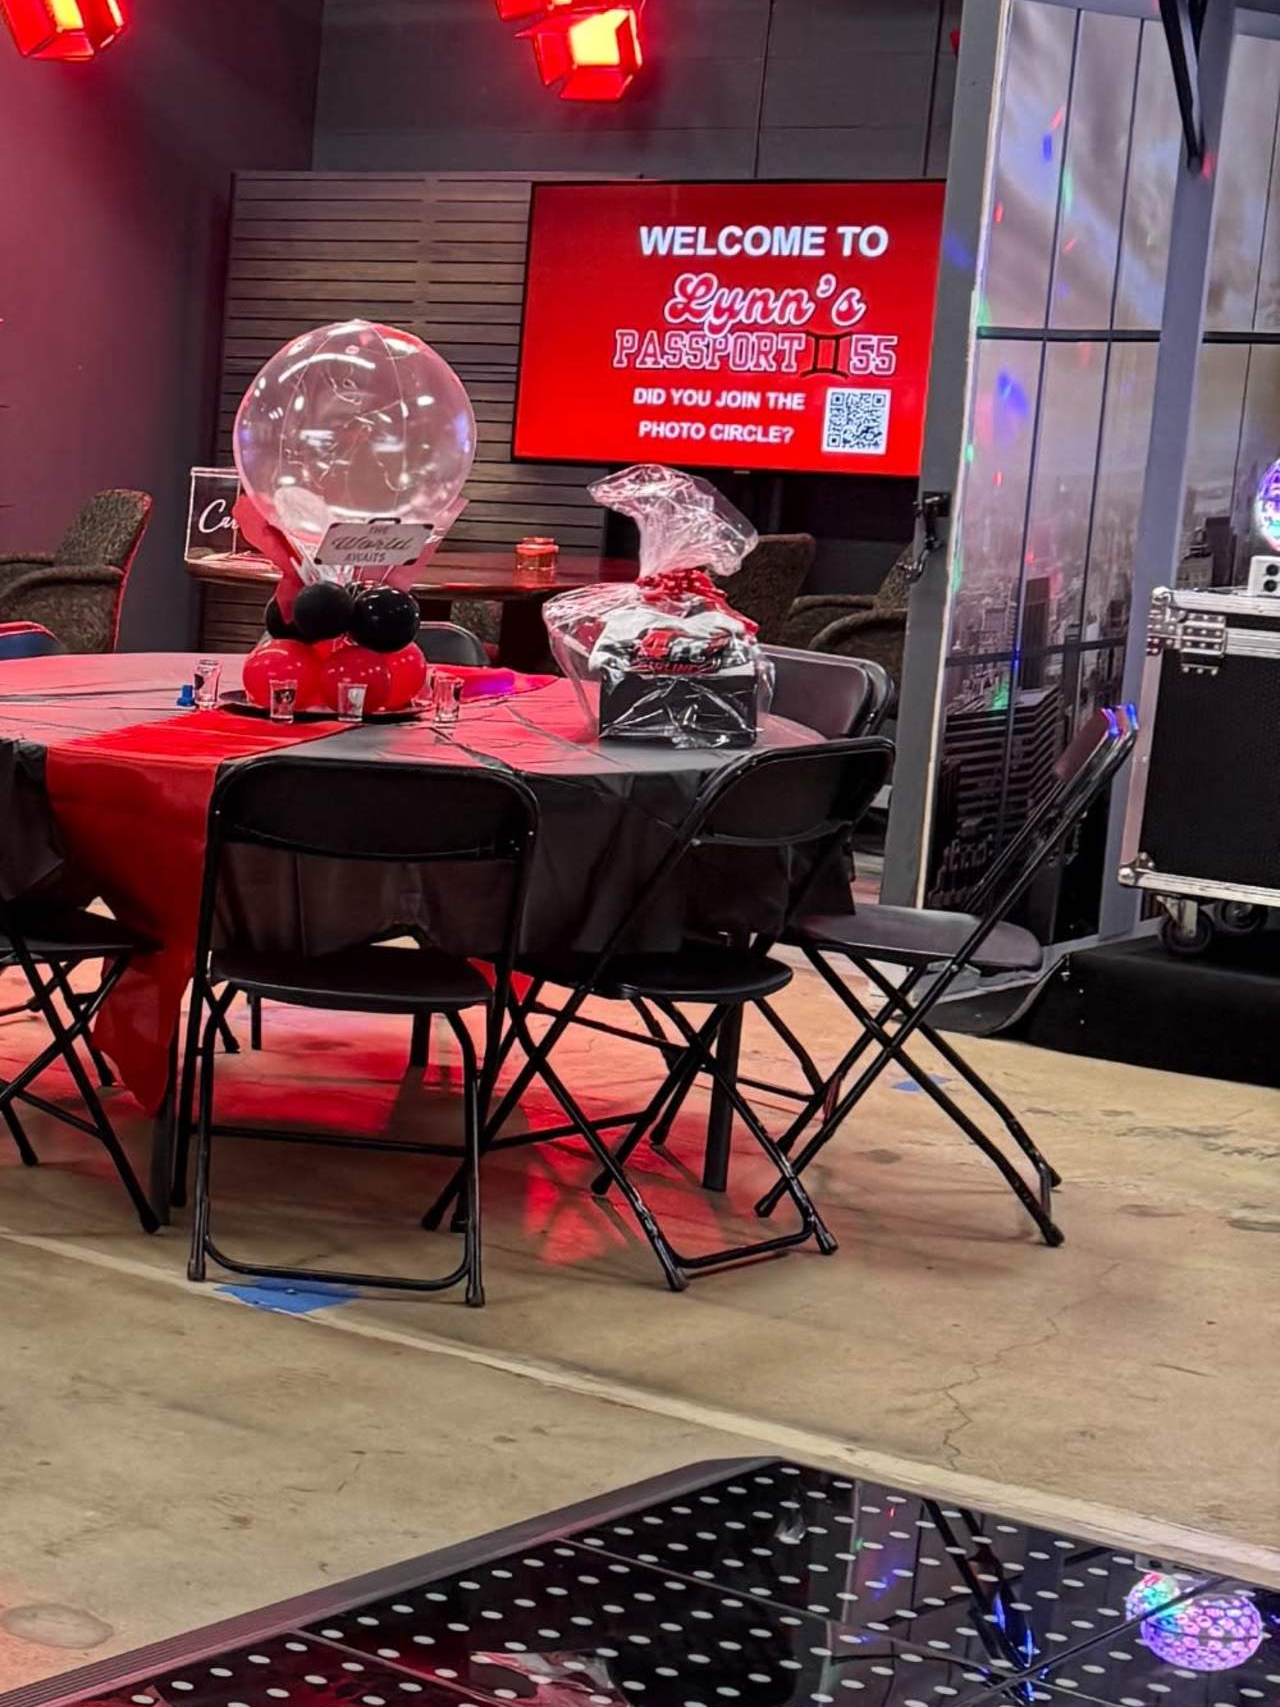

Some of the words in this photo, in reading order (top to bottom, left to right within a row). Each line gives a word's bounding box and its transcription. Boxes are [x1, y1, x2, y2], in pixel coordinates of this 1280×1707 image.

[640, 225, 827, 257] WELCOME
[836, 225, 890, 258] TO
[663, 271, 868, 337] Lynn's
[612, 328, 807, 374] PASSPORT
[849, 335, 898, 376] 55
[633, 388, 667, 406] DID
[670, 389, 711, 407] YOU
[714, 390, 761, 409] JOIN
[766, 392, 805, 410] THE
[639, 421, 704, 441] PHOTO
[709, 422, 794, 443] CIRCLE?
